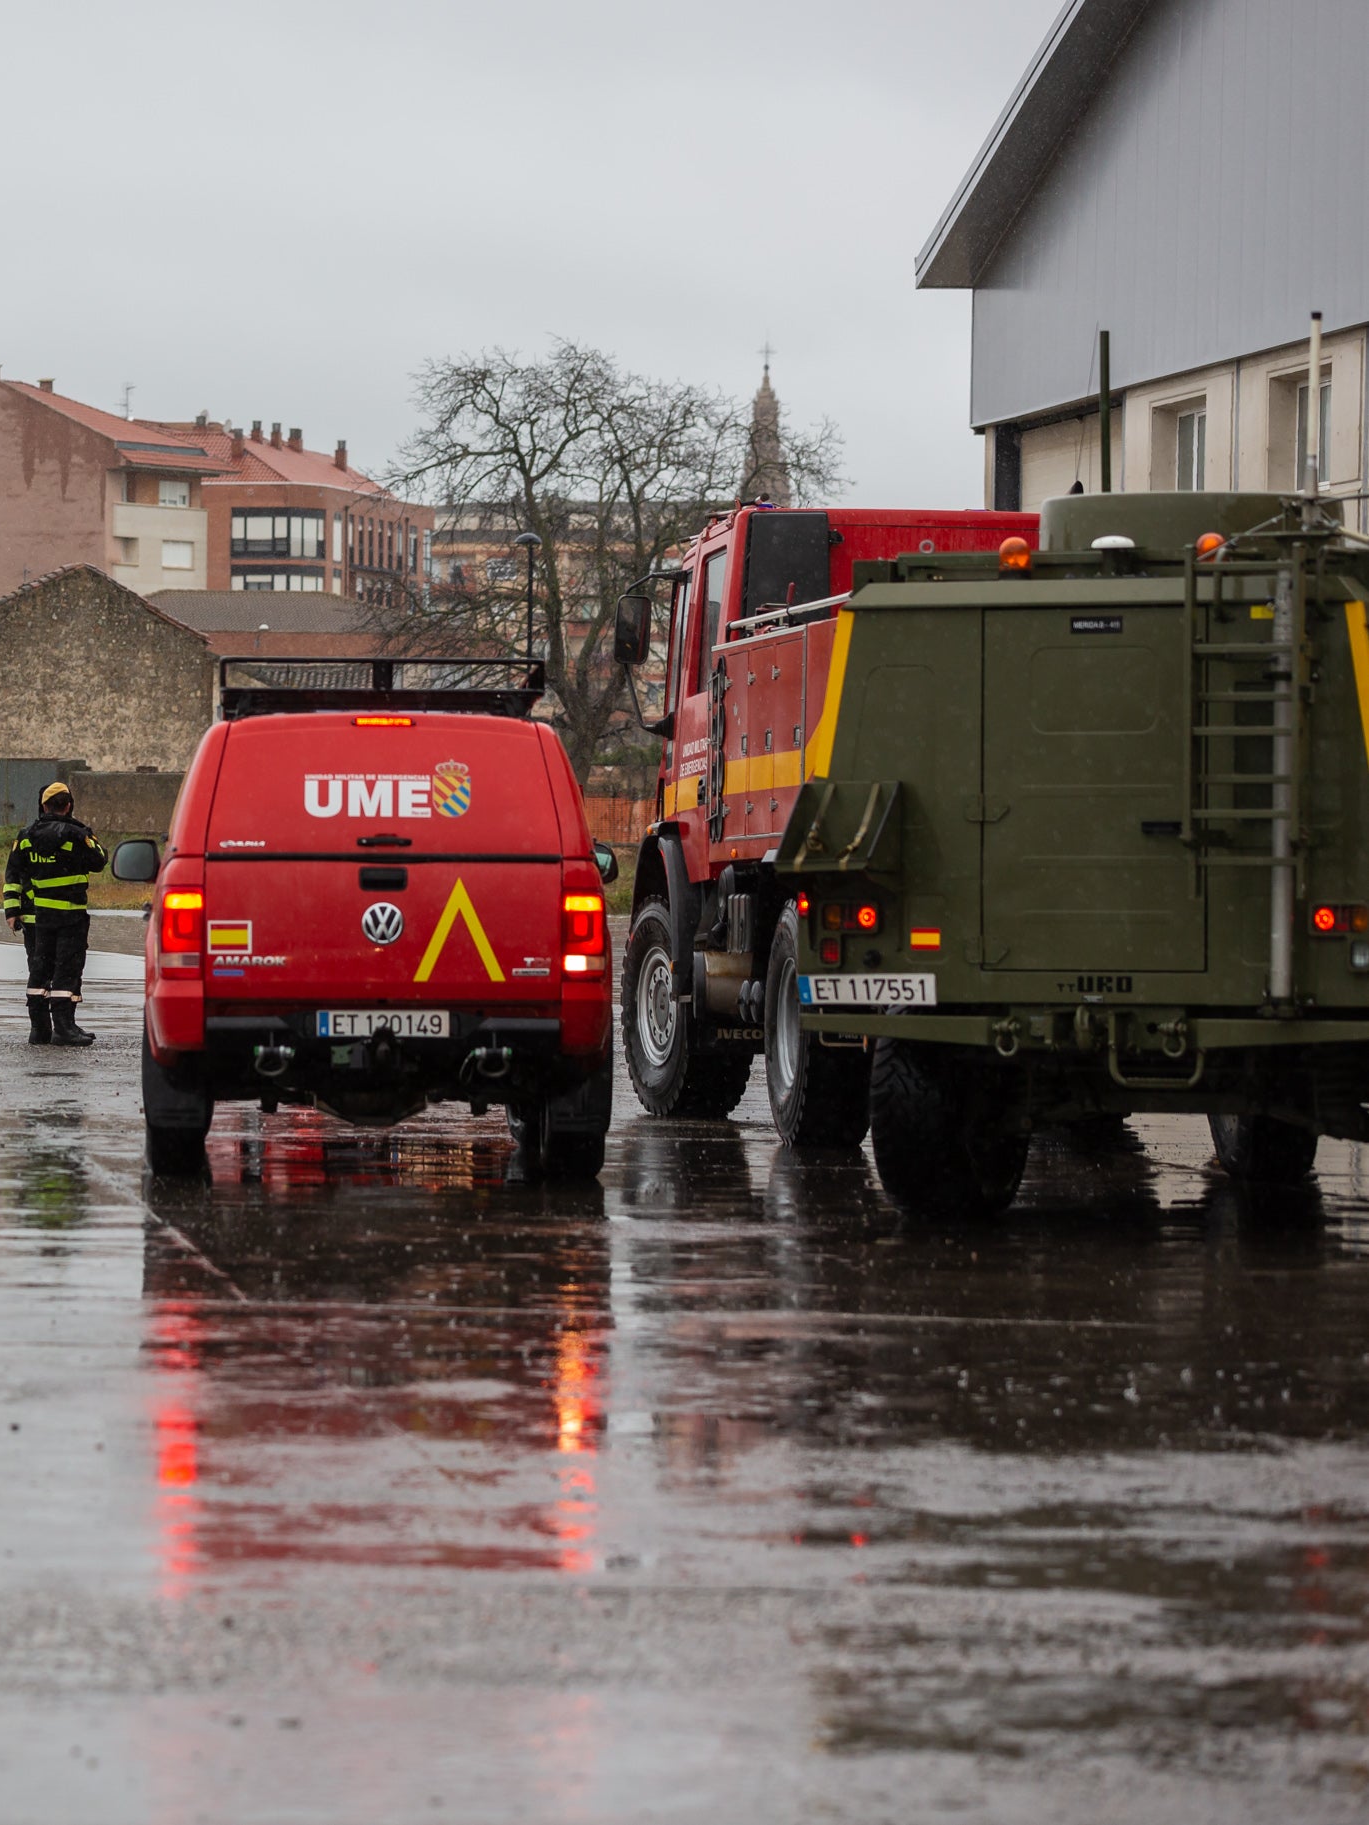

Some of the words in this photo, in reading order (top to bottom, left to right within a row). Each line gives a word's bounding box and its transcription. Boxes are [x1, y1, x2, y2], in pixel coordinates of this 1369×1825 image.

[304, 780, 431, 818] UME
[214, 955, 287, 967] AMAROK
[814, 978, 841, 1000] ET
[848, 978, 927, 1001] 117551
[333, 1014, 359, 1035] ET
[366, 1014, 443, 1035] 120149
[716, 1028, 764, 1040] IVECO
